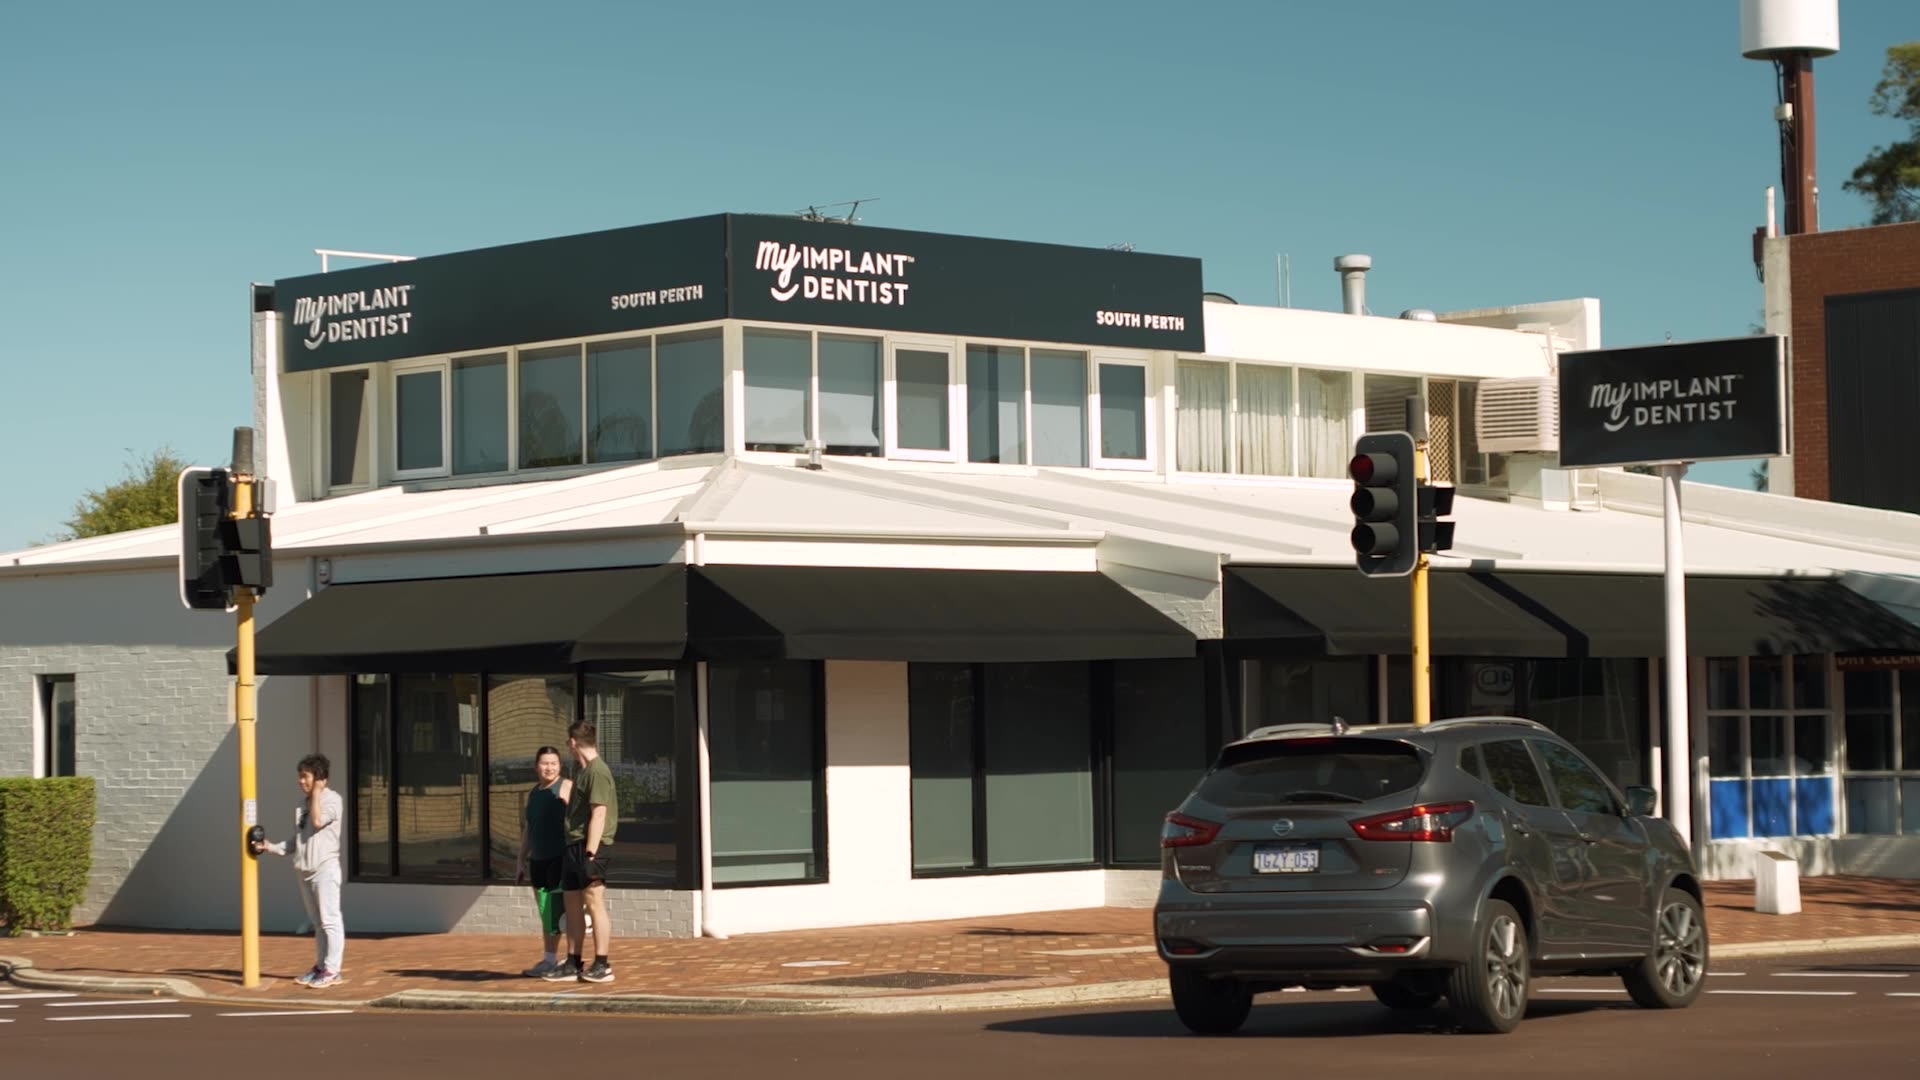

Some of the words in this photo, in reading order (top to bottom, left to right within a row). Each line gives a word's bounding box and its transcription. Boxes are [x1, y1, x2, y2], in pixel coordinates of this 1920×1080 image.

[611, 290, 656, 310] SOUTH
[660, 284, 703, 304] PERTH
[804, 275, 909, 306] DENTIST
[328, 312, 411, 343] DENTIST
[1096, 310, 1141, 328] SOUTH
[1144, 314, 1184, 331] PERTH
[1634, 400, 1737, 426] DENTIST
